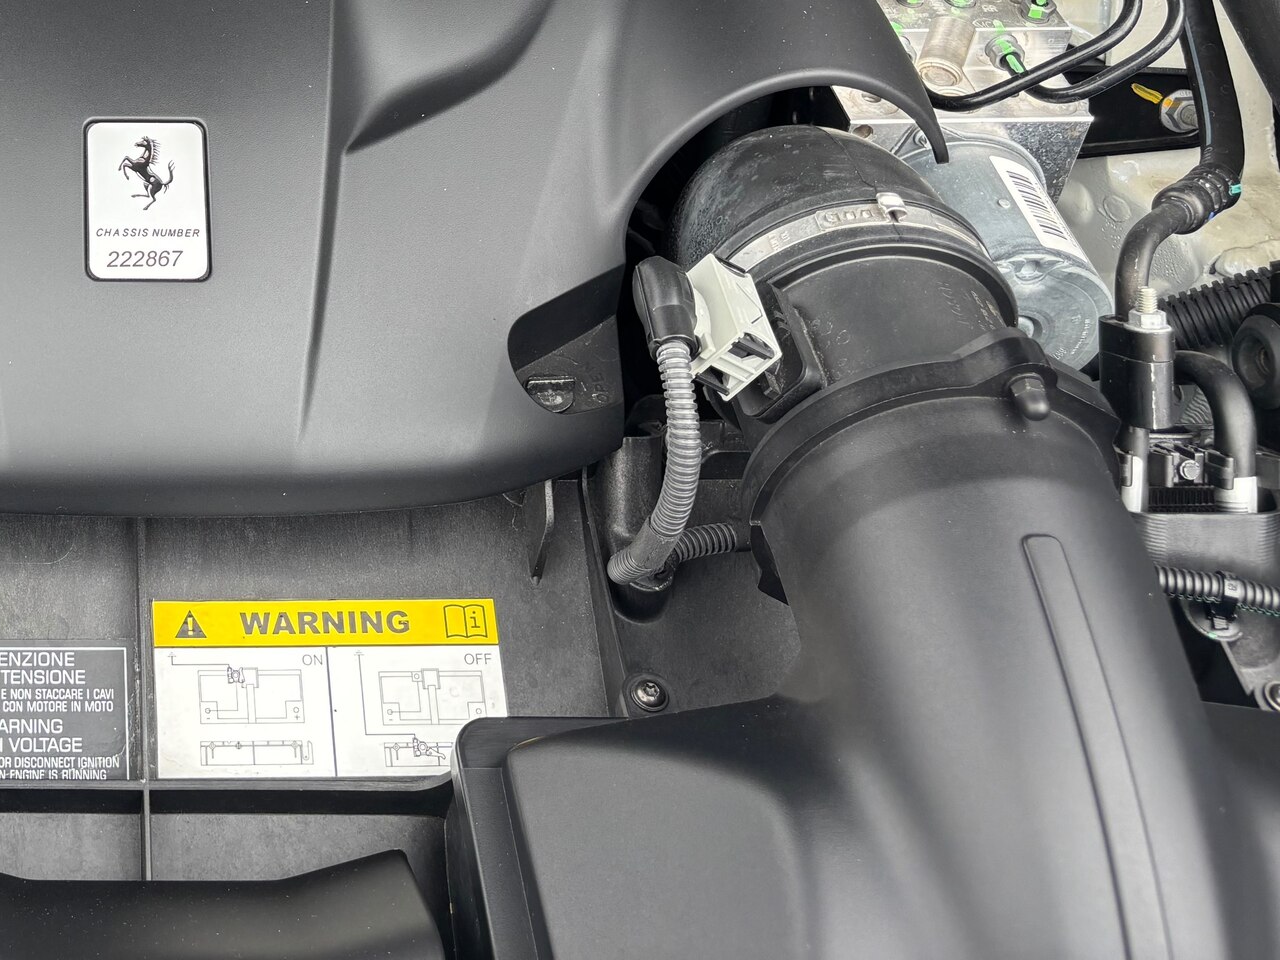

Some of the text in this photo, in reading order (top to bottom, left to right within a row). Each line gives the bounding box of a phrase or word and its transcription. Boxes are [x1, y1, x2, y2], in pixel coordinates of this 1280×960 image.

[96, 228, 200, 238] CHASSIS NUMBER
[106, 250, 184, 268] 222867
[239, 610, 410, 635] WARNING
[301, 654, 323, 666] ON
[463, 652, 492, 665] OFF
[0, 670, 86, 684] TENSIONE
[2, 688, 6, 700] E
[10, 688, 32, 700] NON
[36, 688, 83, 700] STACCARE
[87, 688, 89, 700] I
[94, 688, 114, 700] CAVI
[2, 701, 23, 712] CON
[26, 701, 68, 712] MOTORE
[72, 701, 81, 712] IN
[84, 701, 114, 712] MOTO
[8, 737, 82, 752] VOLTAGE
[14, 756, 76, 768] DISCONNECT
[78, 756, 120, 768] IGNITION
[48, 769, 58, 780] IS
